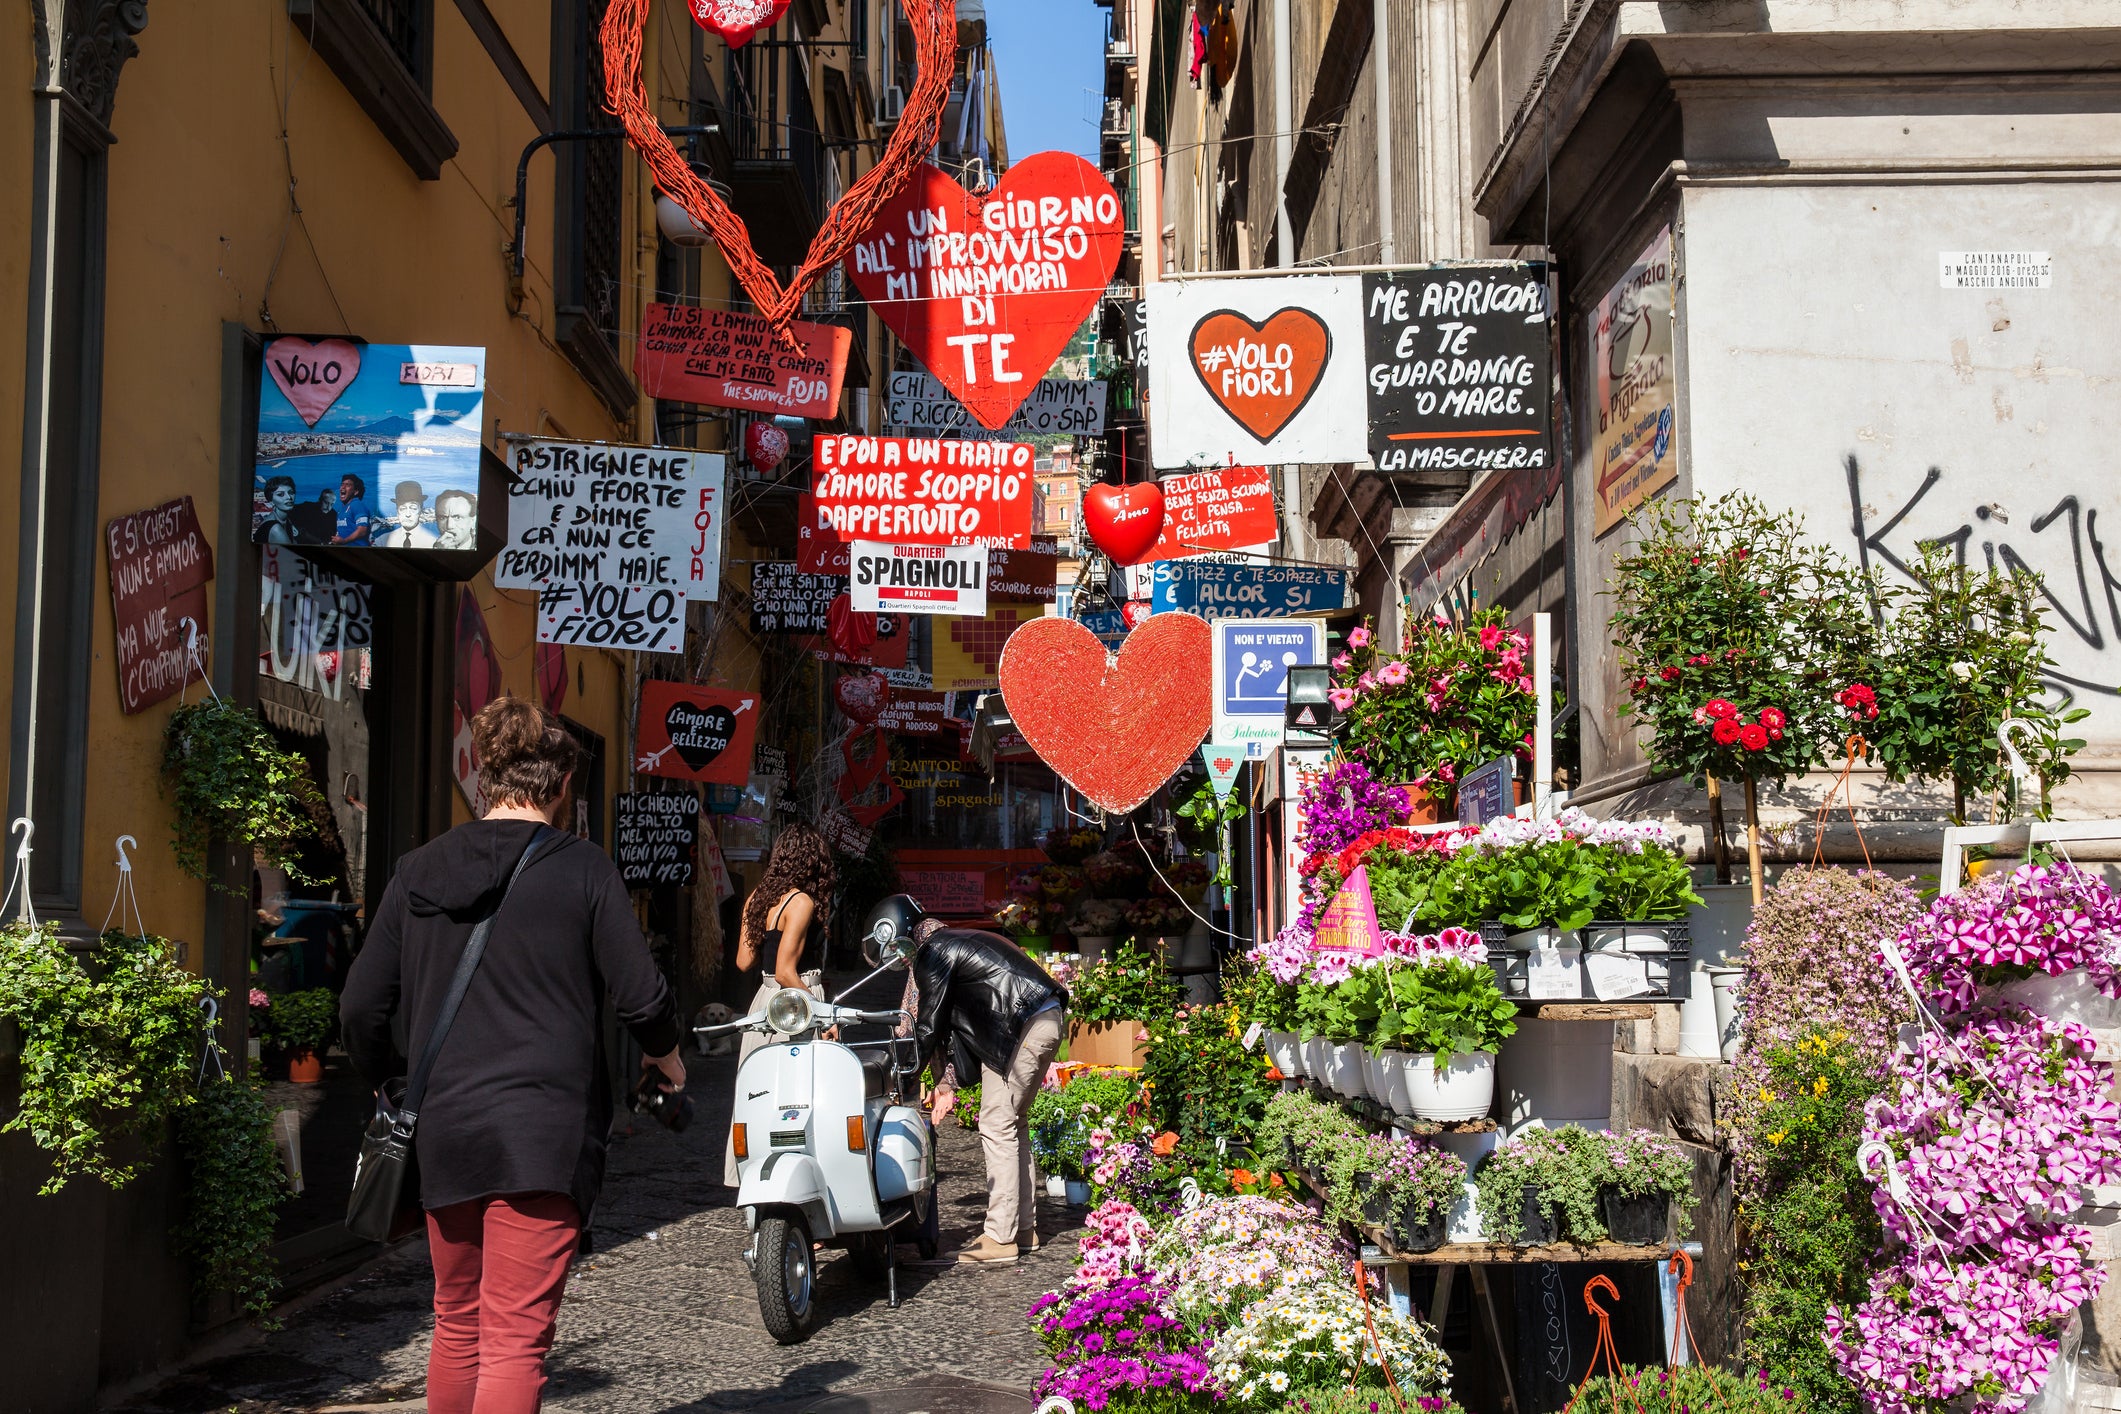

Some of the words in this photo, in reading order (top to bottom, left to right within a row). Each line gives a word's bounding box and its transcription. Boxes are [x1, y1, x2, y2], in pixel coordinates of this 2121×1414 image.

[907, 206, 947, 236] UN
[908, 226, 1088, 269] IMPROVVISO
[1964, 253, 2032, 265] CANTANAPOLI
[886, 272, 918, 300] MI
[931, 262, 1068, 298] INNAMORAI
[1956, 265, 1988, 276] MAGGIO
[1991, 265, 2011, 276] 2016
[1957, 277, 1995, 288] MASCHIO
[2000, 277, 2039, 288] ANGIOINO
[1369, 285, 1409, 324] ME
[734, 333, 763, 348] NUN
[1396, 325, 1420, 358] E
[1437, 321, 1478, 356] TE
[946, 333, 1023, 384] TE
[1200, 337, 1294, 373] #VOLO
[274, 355, 342, 388] VOLO
[403, 365, 454, 381] FIORI
[686, 358, 710, 371] CHE
[741, 365, 776, 382] FATTO
[1369, 355, 1535, 396] GUARDANNE
[786, 375, 828, 405] FOJA
[516, 446, 690, 481] ASTRIGNEME
[821, 438, 836, 465] E
[884, 441, 901, 467] A
[907, 438, 941, 465] UN
[943, 440, 1030, 468] TRATTO
[1379, 448, 1407, 471] LA
[1408, 445, 1547, 470] MASCHERA
[589, 480, 687, 508] FFORTE
[1109, 493, 1130, 510] Ti
[1164, 494, 1194, 511] BENE
[1196, 487, 1229, 504] SENZA
[817, 502, 981, 536] DAPPERTUTTO
[1113, 507, 1149, 524] Amo
[1182, 508, 1196, 522] CE
[566, 528, 611, 549] NUN
[618, 529, 656, 549] CE
[894, 545, 946, 559] QUARTIERI
[857, 556, 981, 591] SPAGNOLI
[904, 589, 931, 599] NAPOLI
[1166, 584, 1180, 604] E
[1201, 584, 1267, 604] ALLOR
[1286, 585, 1312, 607] SI
[887, 601, 911, 610] Quartieri
[912, 603, 936, 612] Spagnoli
[937, 604, 957, 612] Official
[118, 623, 140, 665] MA
[1234, 634, 1254, 645] NON
[1267, 634, 1304, 645] VIETATO
[906, 721, 939, 732] ADDOSSO
[1220, 719, 1281, 742] Salvatore
[672, 733, 727, 751] BELLEZZA
[637, 792, 699, 815] CHIEDEVO
[619, 814, 635, 828] SE
[636, 814, 684, 829] SALTO
[620, 829, 643, 844] NEL
[647, 829, 693, 844] VUOTO
[653, 843, 679, 861] VIA
[623, 862, 654, 881] CON
